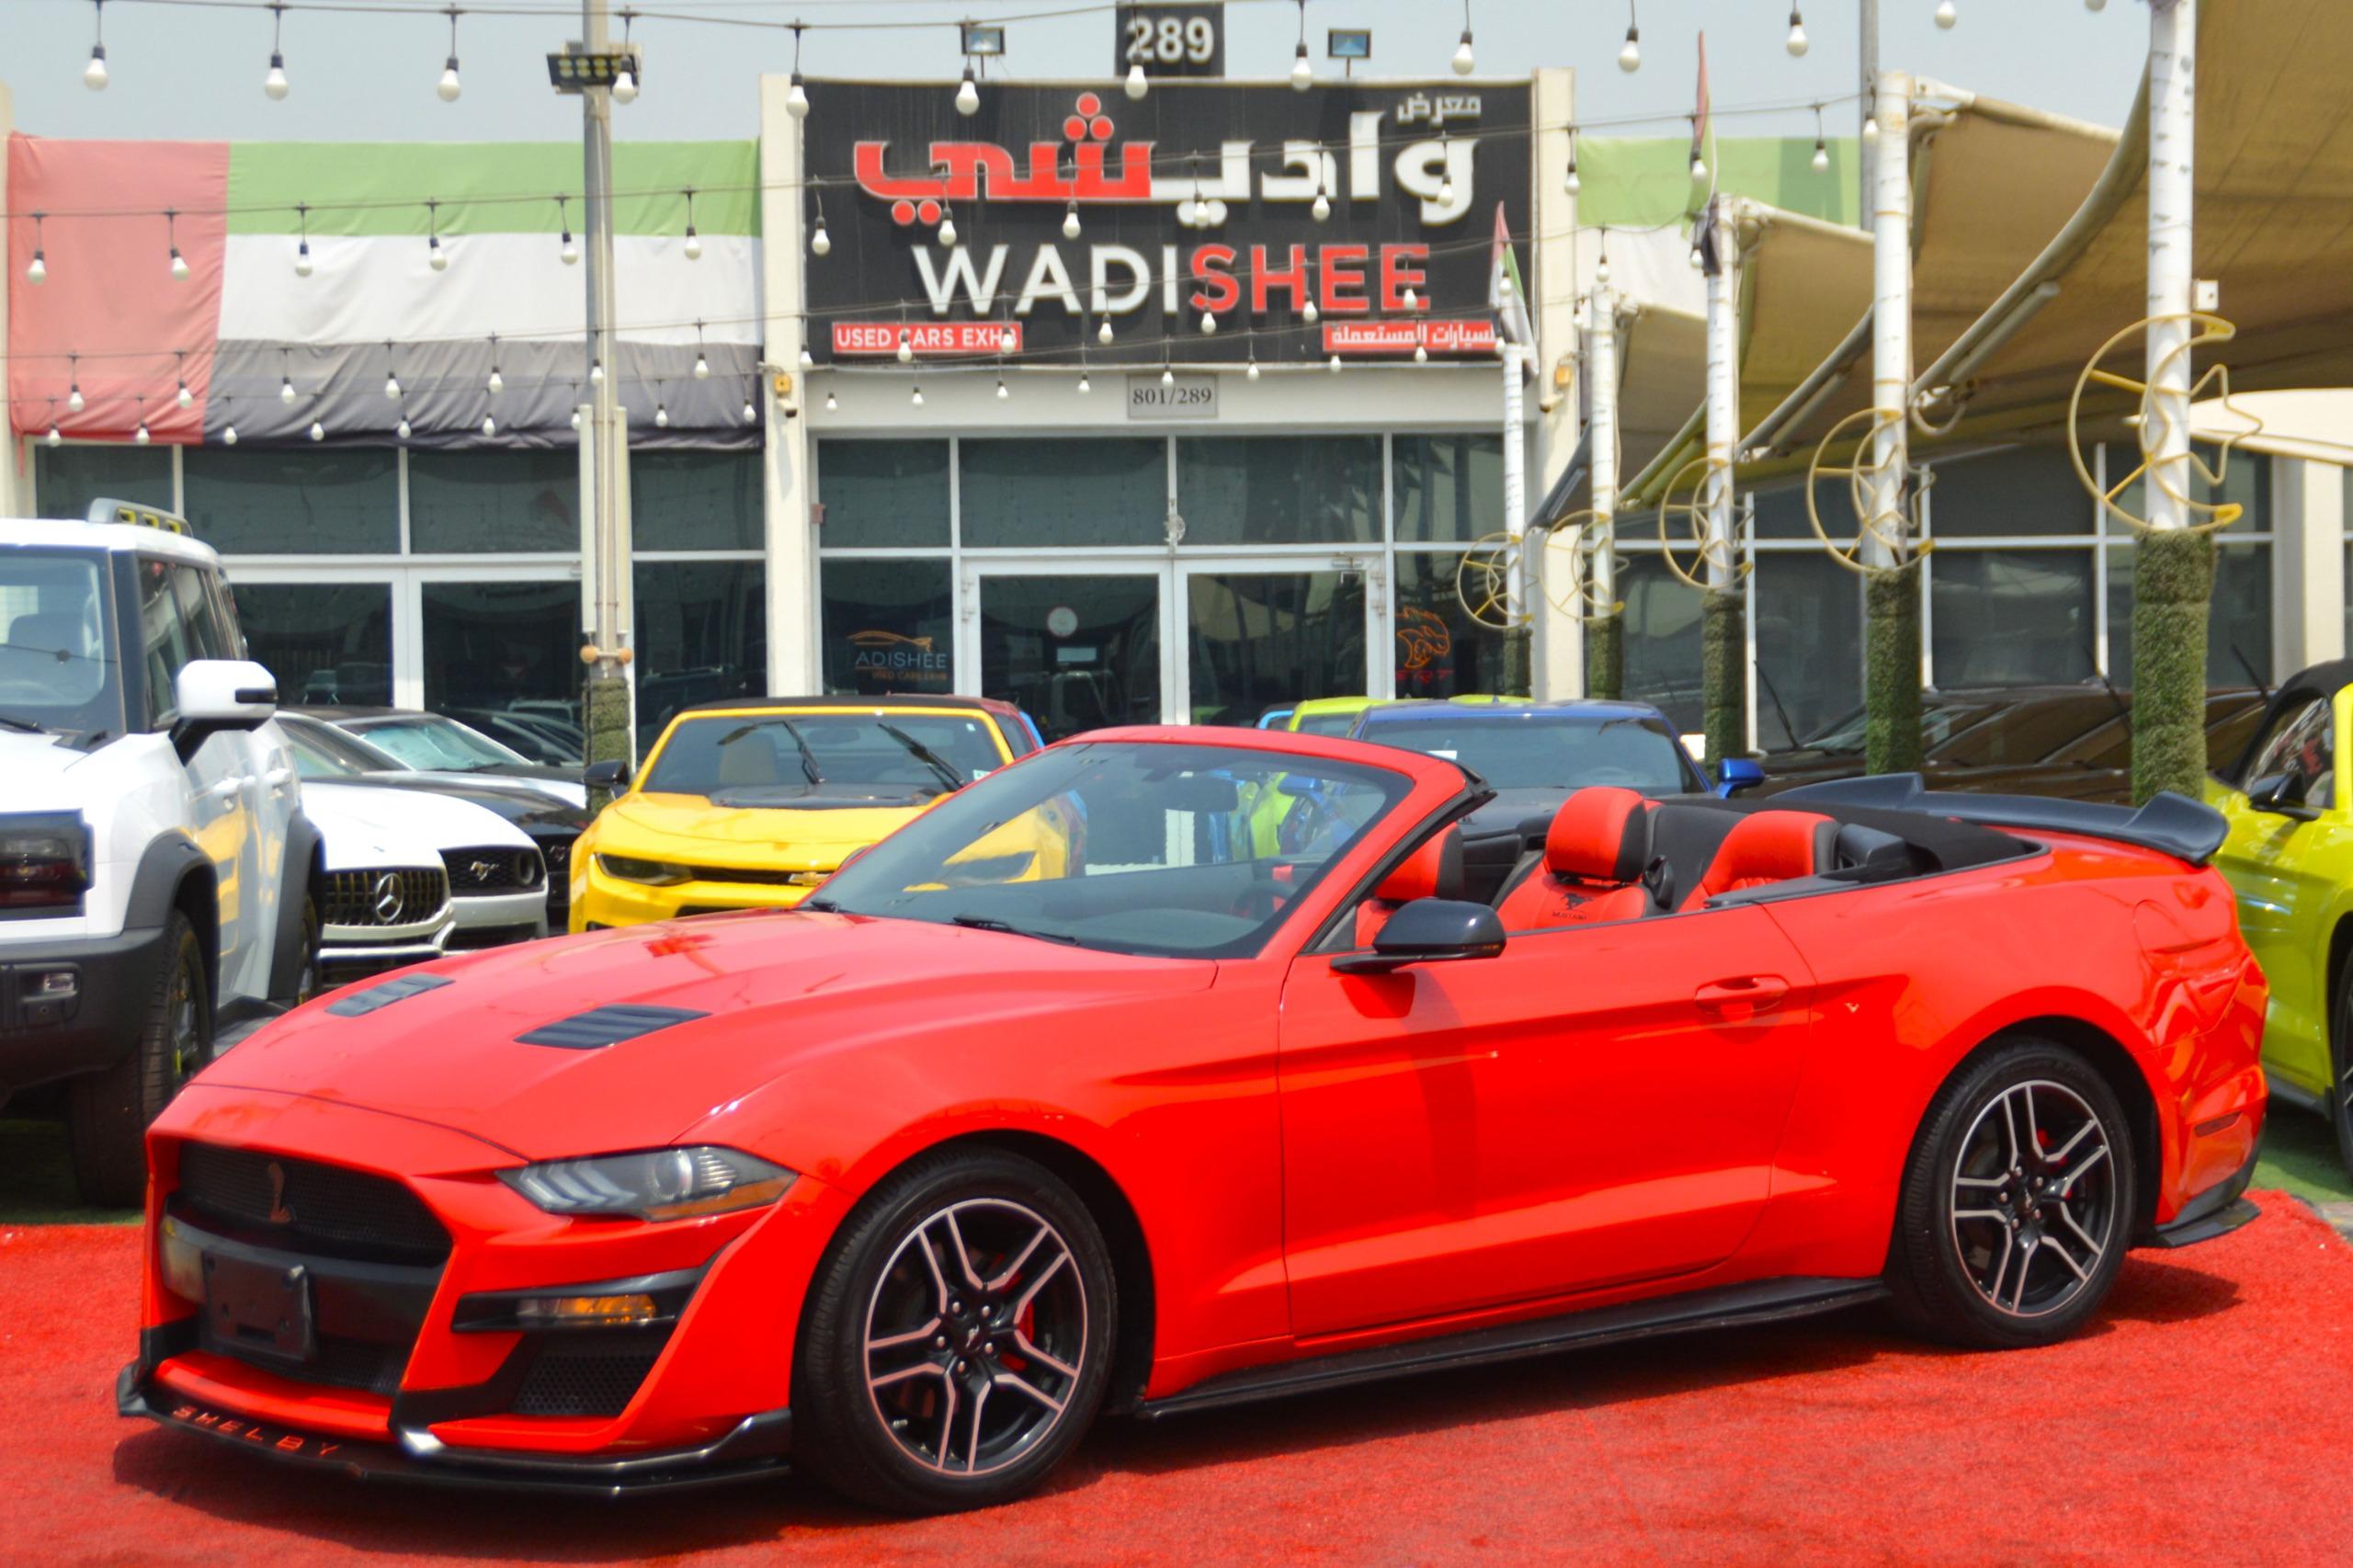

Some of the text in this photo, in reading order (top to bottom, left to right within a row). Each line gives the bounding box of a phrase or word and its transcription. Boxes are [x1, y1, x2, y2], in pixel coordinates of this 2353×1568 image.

[1126, 16, 1213, 61] 289
[1397, 92, 1481, 125] معرض
[836, 327, 892, 347] USED
[898, 327, 954, 347] CARS
[1432, 323, 1496, 349] لسيارات
[1132, 387, 1211, 404] 801/289
[173, 1406, 339, 1456] SHELBY
